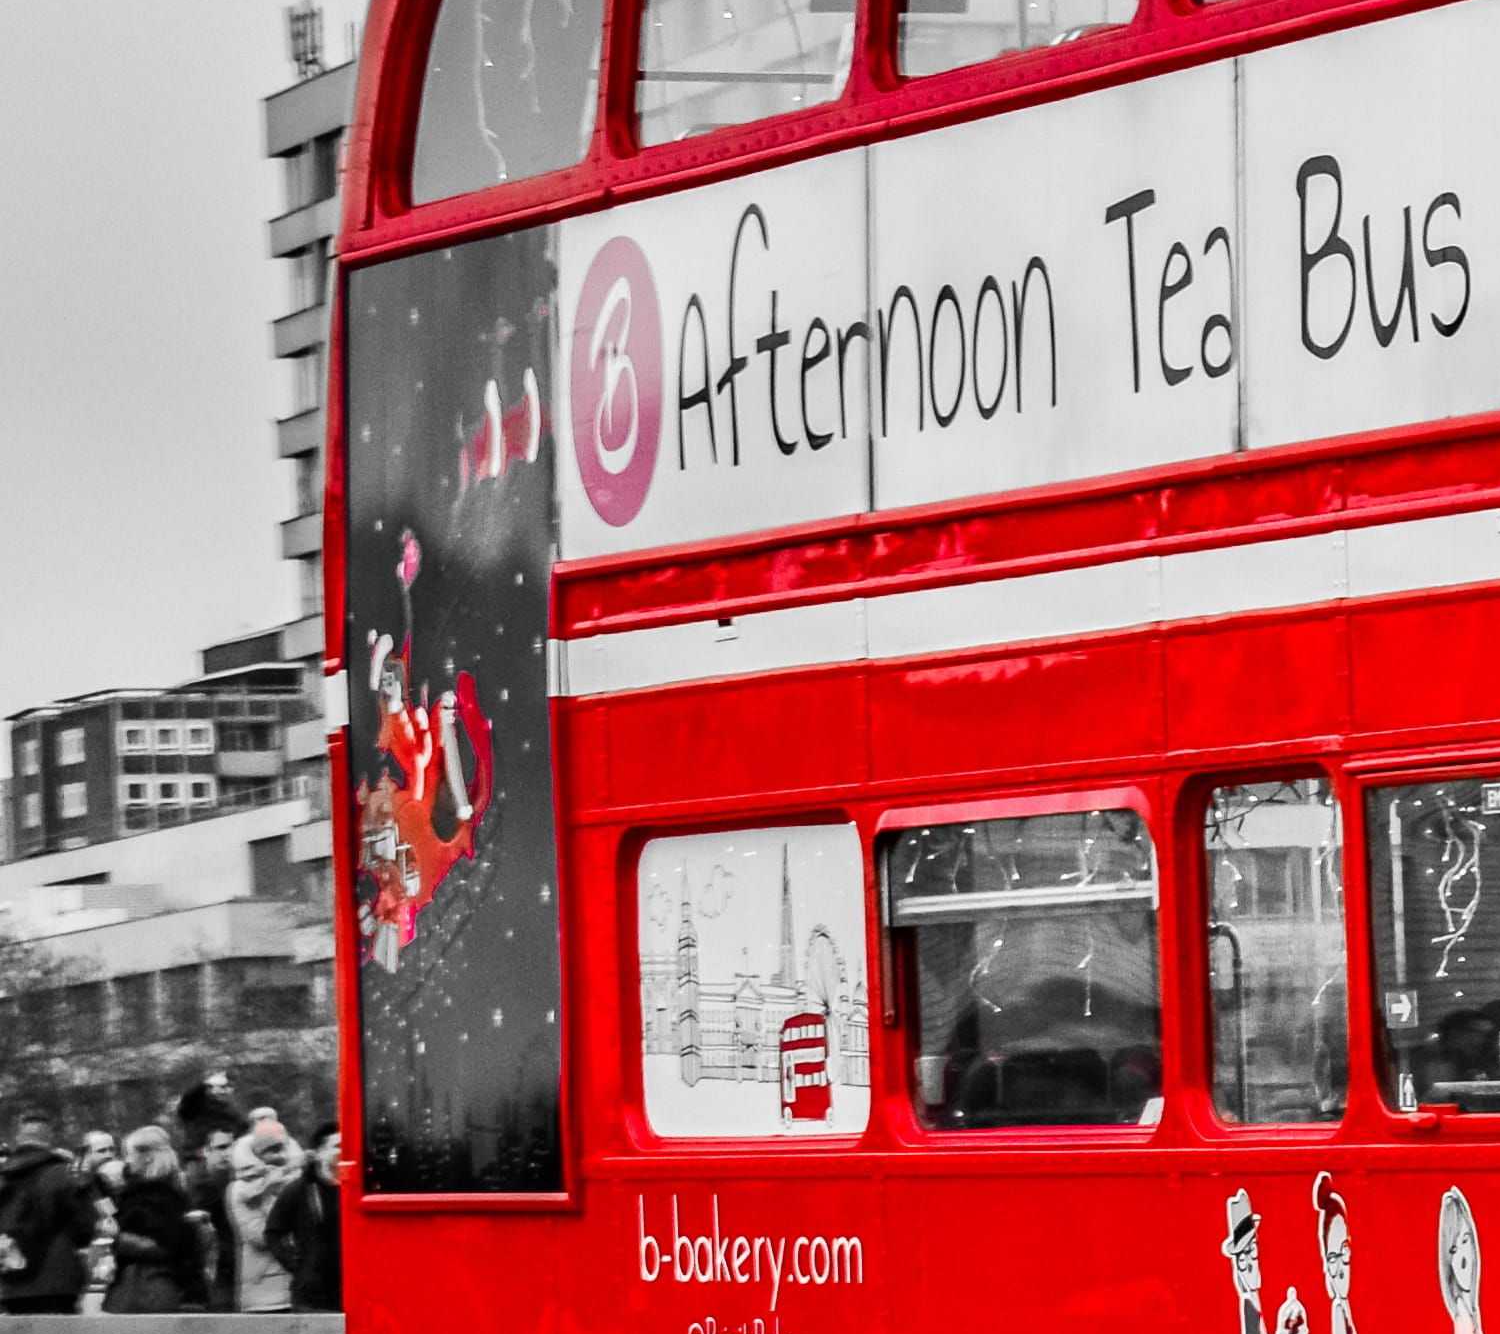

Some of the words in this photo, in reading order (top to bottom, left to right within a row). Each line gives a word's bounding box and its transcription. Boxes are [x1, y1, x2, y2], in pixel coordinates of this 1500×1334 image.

[678, 203, 1057, 471] Afternoon
[1105, 188, 1235, 394] Tea
[1296, 154, 1471, 360] Bus
[638, 1193, 863, 1312] b-bakery.com
